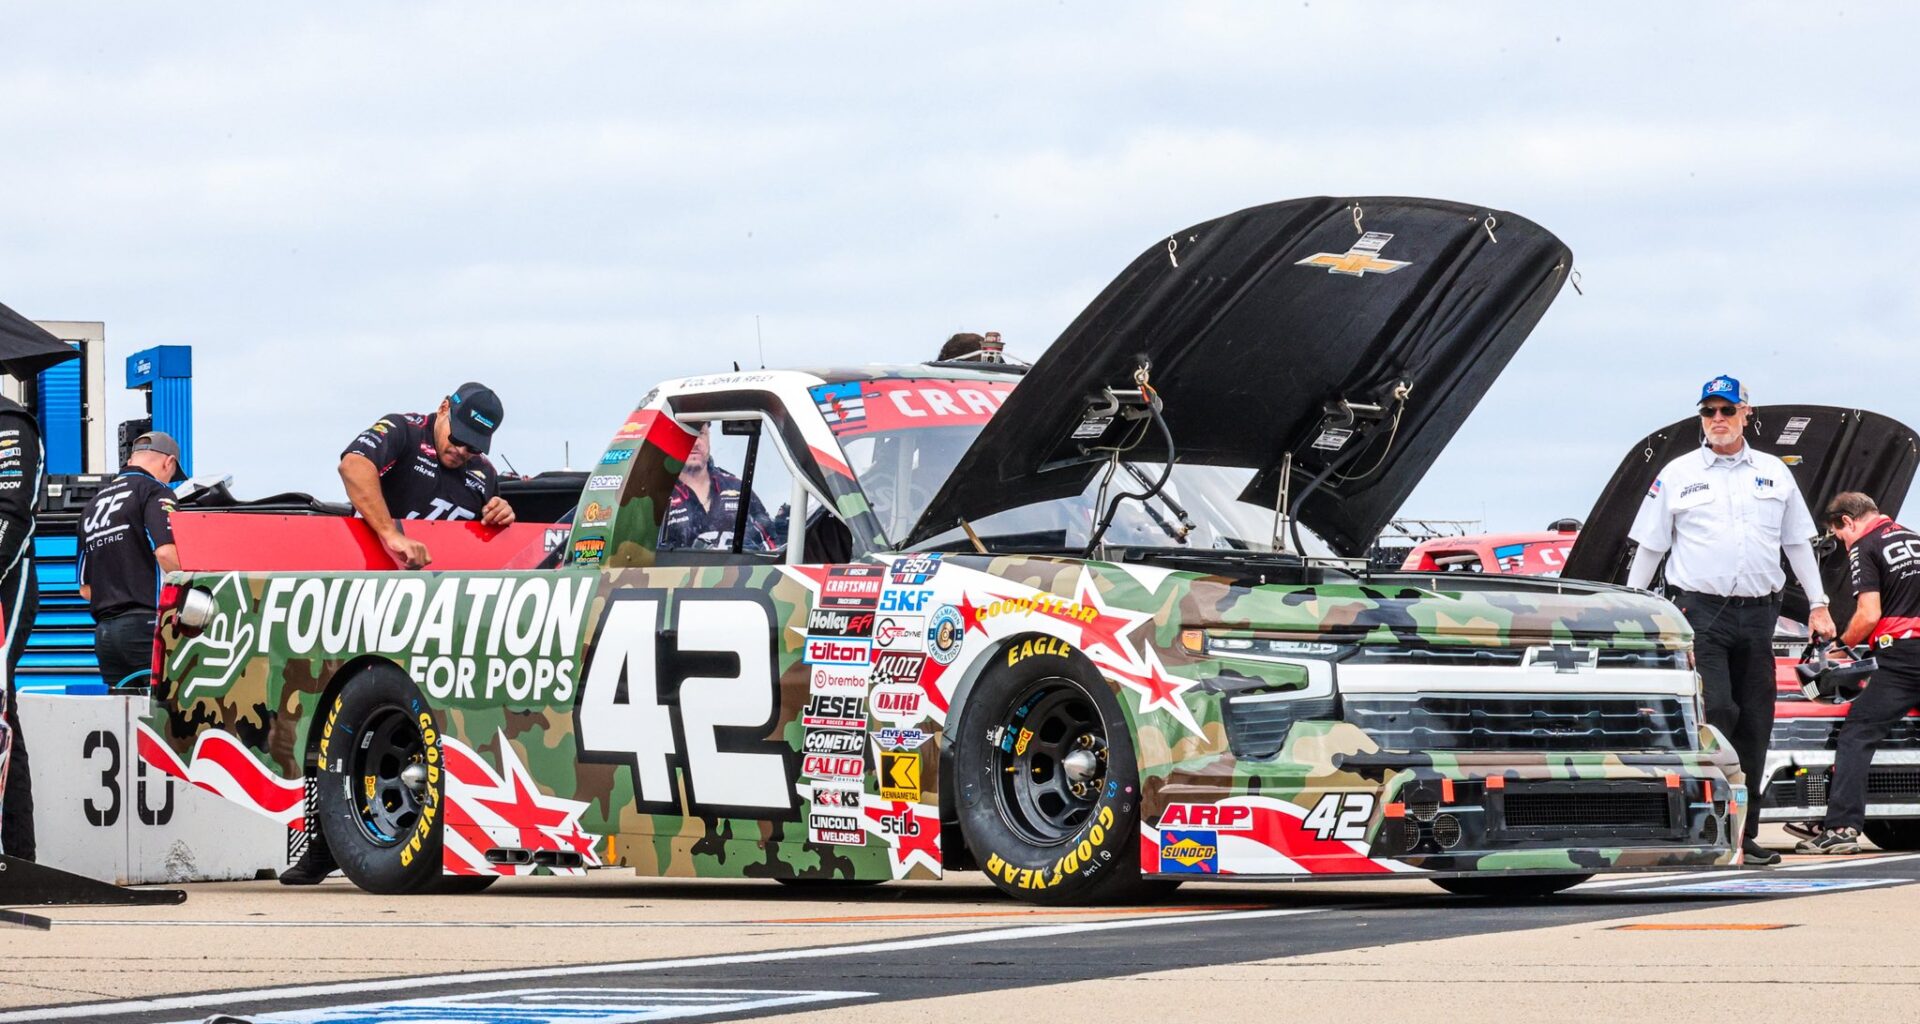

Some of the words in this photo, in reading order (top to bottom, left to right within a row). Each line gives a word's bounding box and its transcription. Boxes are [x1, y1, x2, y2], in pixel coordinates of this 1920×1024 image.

[1680, 483, 1710, 498] OFFICIAL
[901, 560, 929, 573] 250
[825, 580, 880, 593] CRAFTSMAN
[880, 590, 935, 611] SKF
[975, 591, 1099, 625] GOODYEAR
[259, 577, 593, 657] FOUNDATION
[810, 611, 849, 635] Holley
[847, 613, 874, 633] EFI
[810, 642, 867, 662] tilton
[1008, 637, 1071, 668] EAGLE
[879, 656, 922, 677] KLOTZ
[411, 656, 476, 699] FOR
[486, 658, 574, 702] POPS
[828, 673, 866, 688] brembo
[576, 594, 796, 812] 42
[804, 695, 864, 720] JESEL
[317, 694, 344, 771] EAGLE
[805, 732, 864, 752] COMETIC
[881, 729, 899, 738] FIVE
[901, 730, 921, 739] STAR
[804, 756, 864, 777] CALICO
[400, 712, 440, 867] GOODYEAR
[813, 789, 859, 806] KOOKS
[881, 791, 919, 801] KENNAMETAL
[811, 815, 857, 830] LINCOLN
[881, 808, 920, 835] Stilo
[1160, 805, 1251, 826] ARP
[1302, 793, 1375, 841] 42
[820, 831, 861, 844] WELDERS
[987, 806, 1114, 889] GOODYEAR
[1163, 846, 1215, 859] SUNOCO
